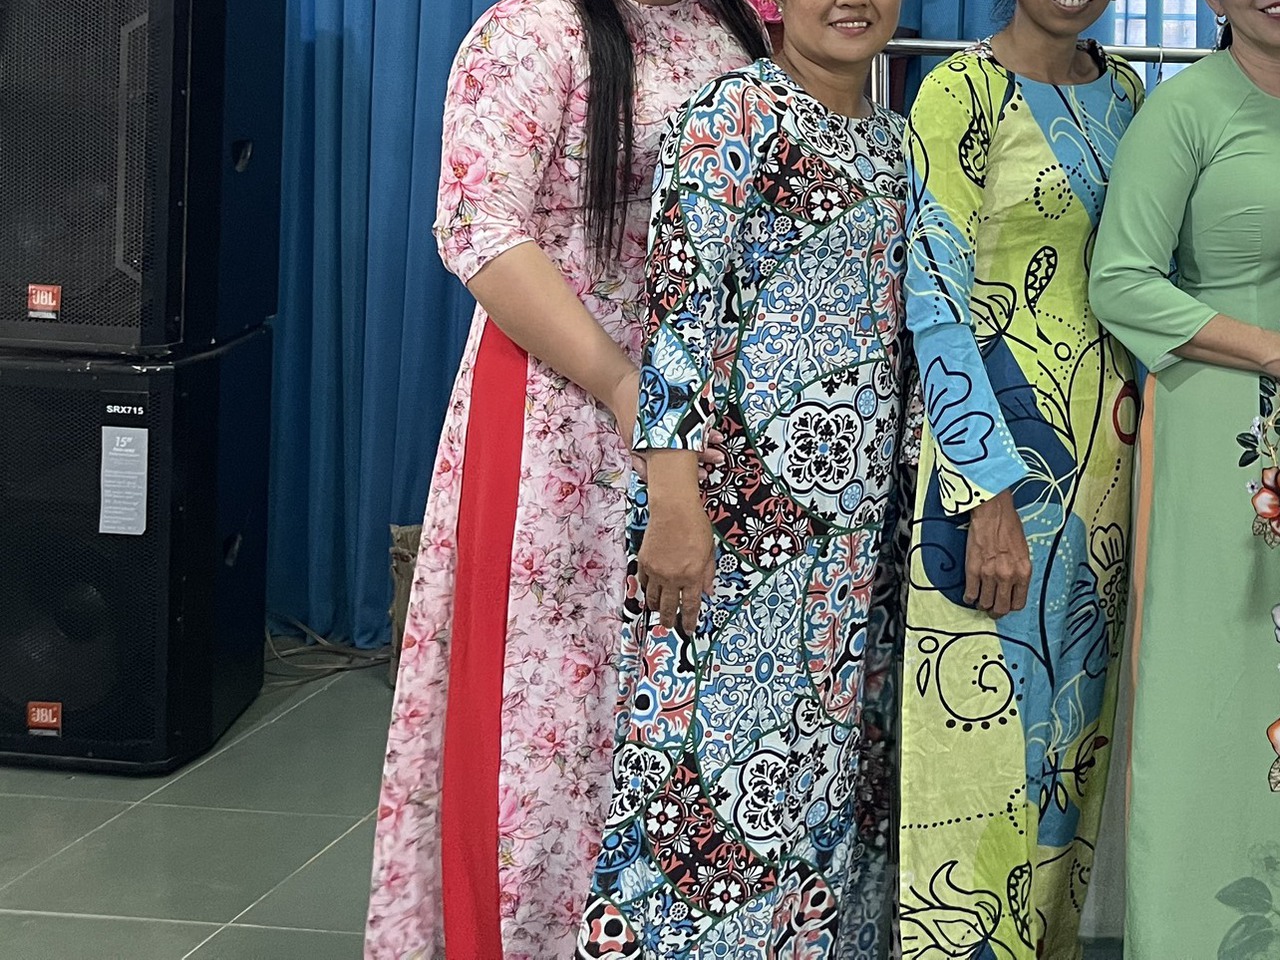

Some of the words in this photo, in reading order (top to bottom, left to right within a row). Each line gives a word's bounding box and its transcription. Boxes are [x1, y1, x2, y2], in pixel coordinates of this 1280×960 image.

[32, 289, 57, 305] JBL
[106, 405, 144, 415] SRX715
[31, 707, 57, 723] JBL
